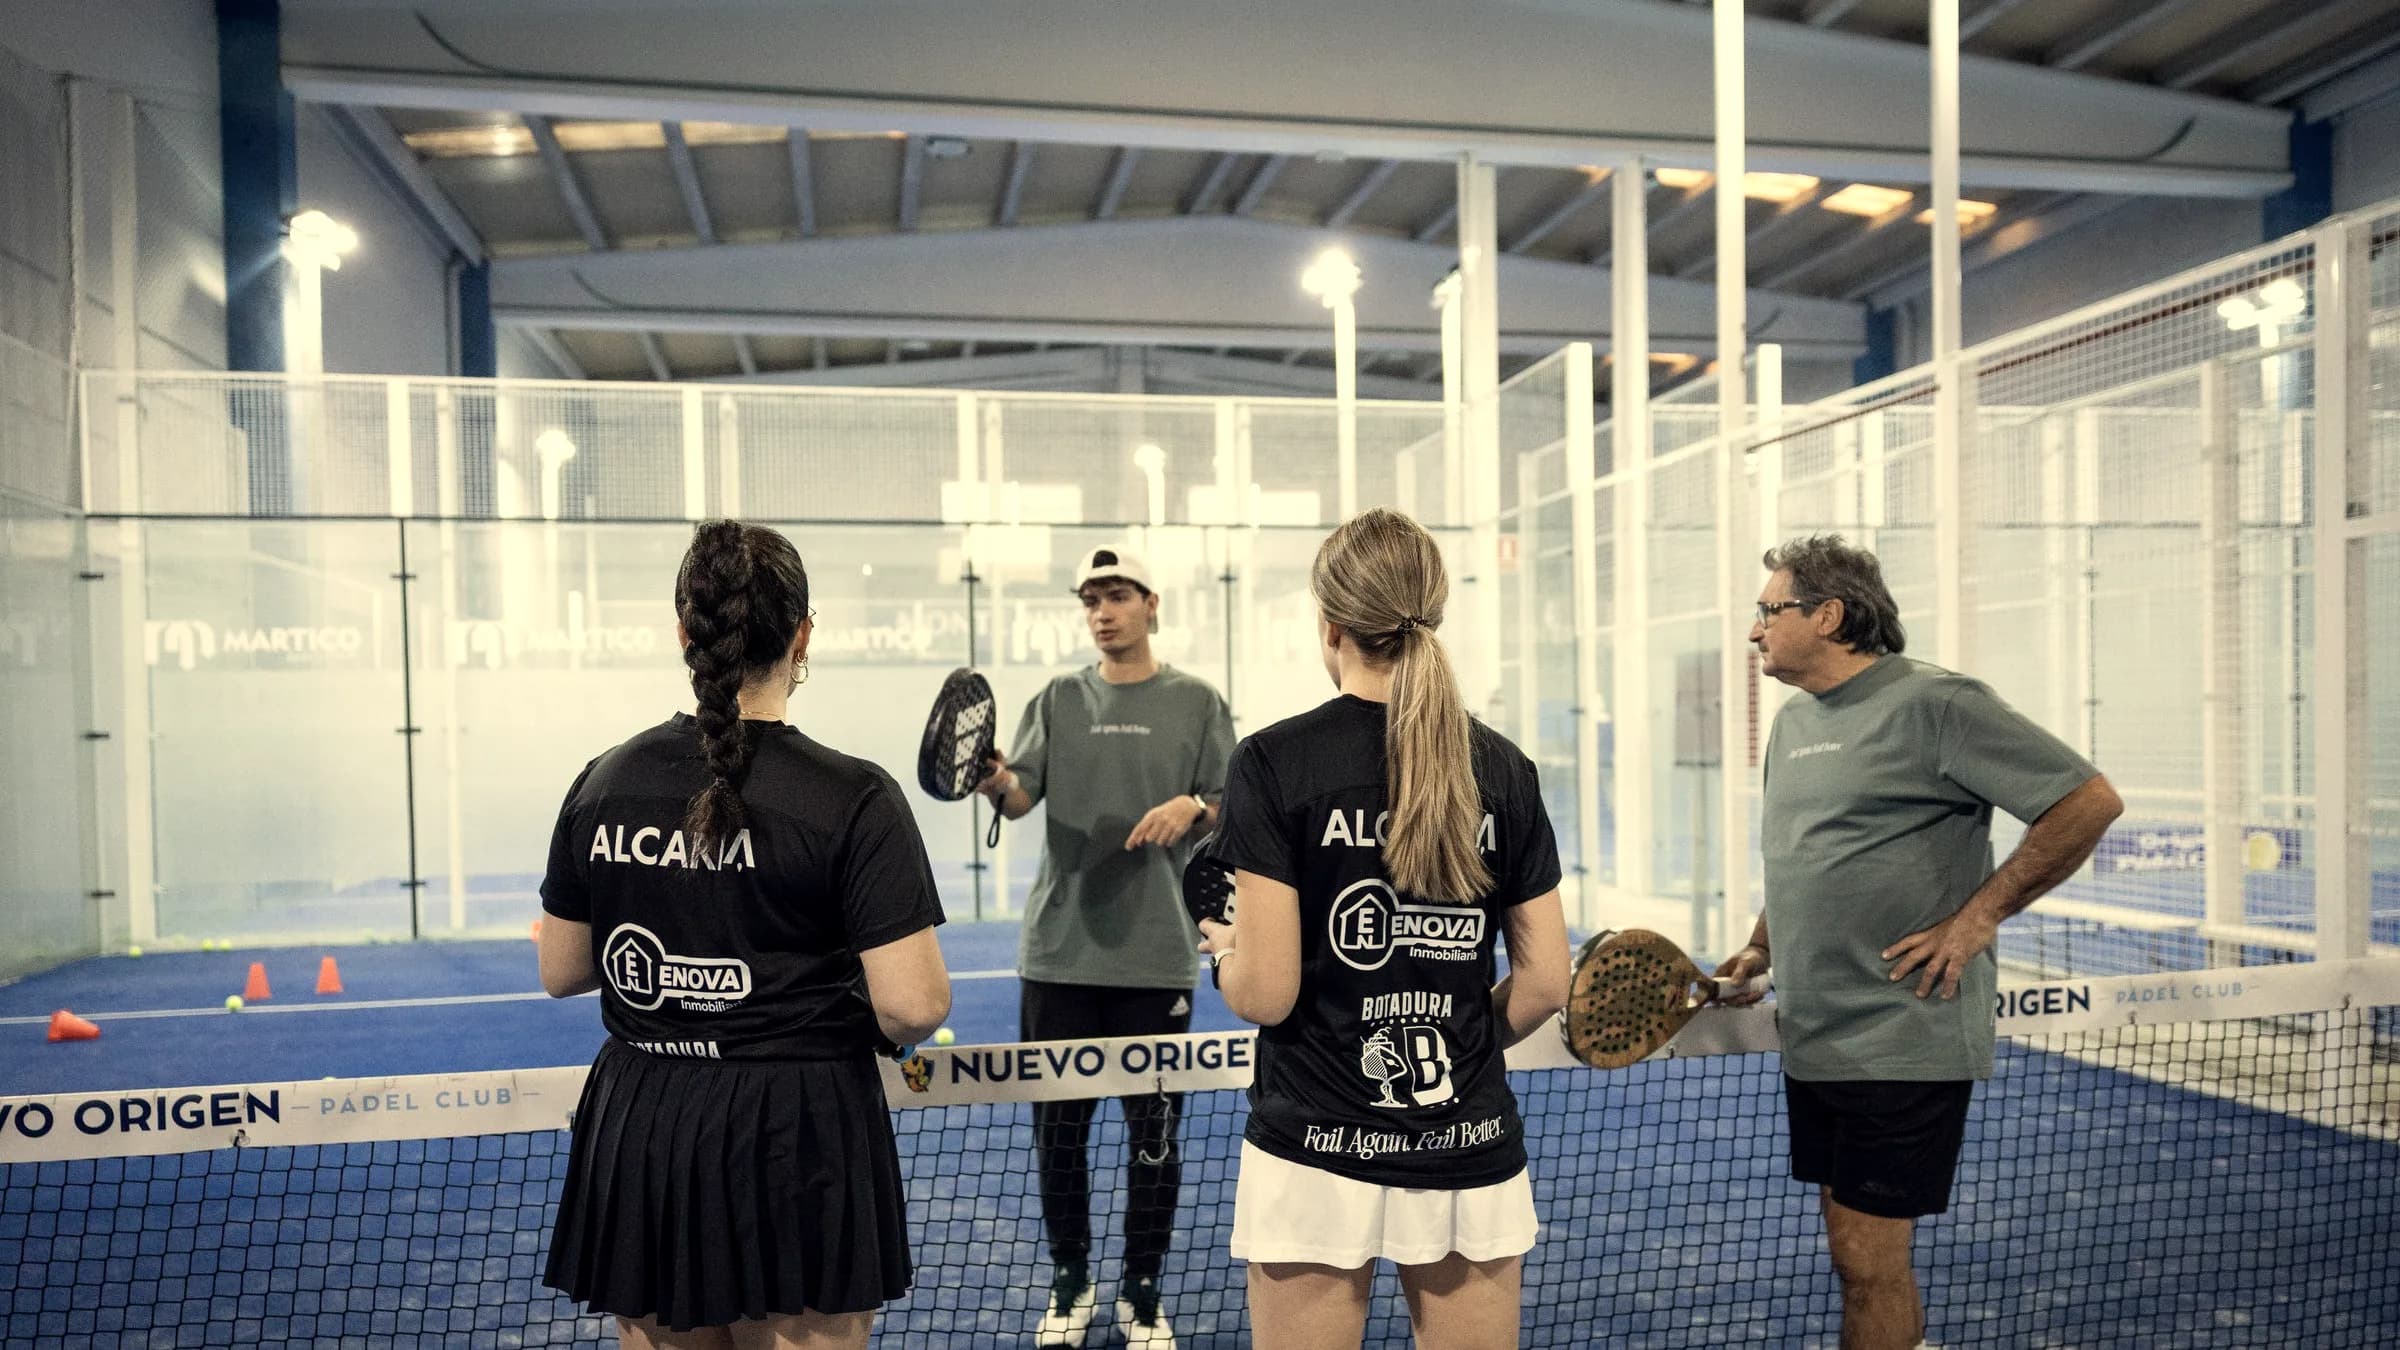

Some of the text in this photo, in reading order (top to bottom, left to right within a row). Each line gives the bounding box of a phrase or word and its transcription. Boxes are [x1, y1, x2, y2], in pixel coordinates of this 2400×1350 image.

[222, 626, 362, 652] MARTICO
[1391, 915, 1476, 940] ENOVA
[1409, 946, 1477, 961] Inmobiliaria
[659, 965, 741, 990] ENOVA
[1361, 991, 1452, 1020] BOTADURA
[1996, 985, 2090, 1018] RIGEN
[2191, 981, 2243, 999] CLUB
[951, 1037, 1250, 1084] NUEVO ORIGE
[74, 1090, 280, 1135] ORIGEN
[436, 1088, 512, 1108] CLUB
[1304, 1115, 1504, 1159] Fail Again. Fail Better.
